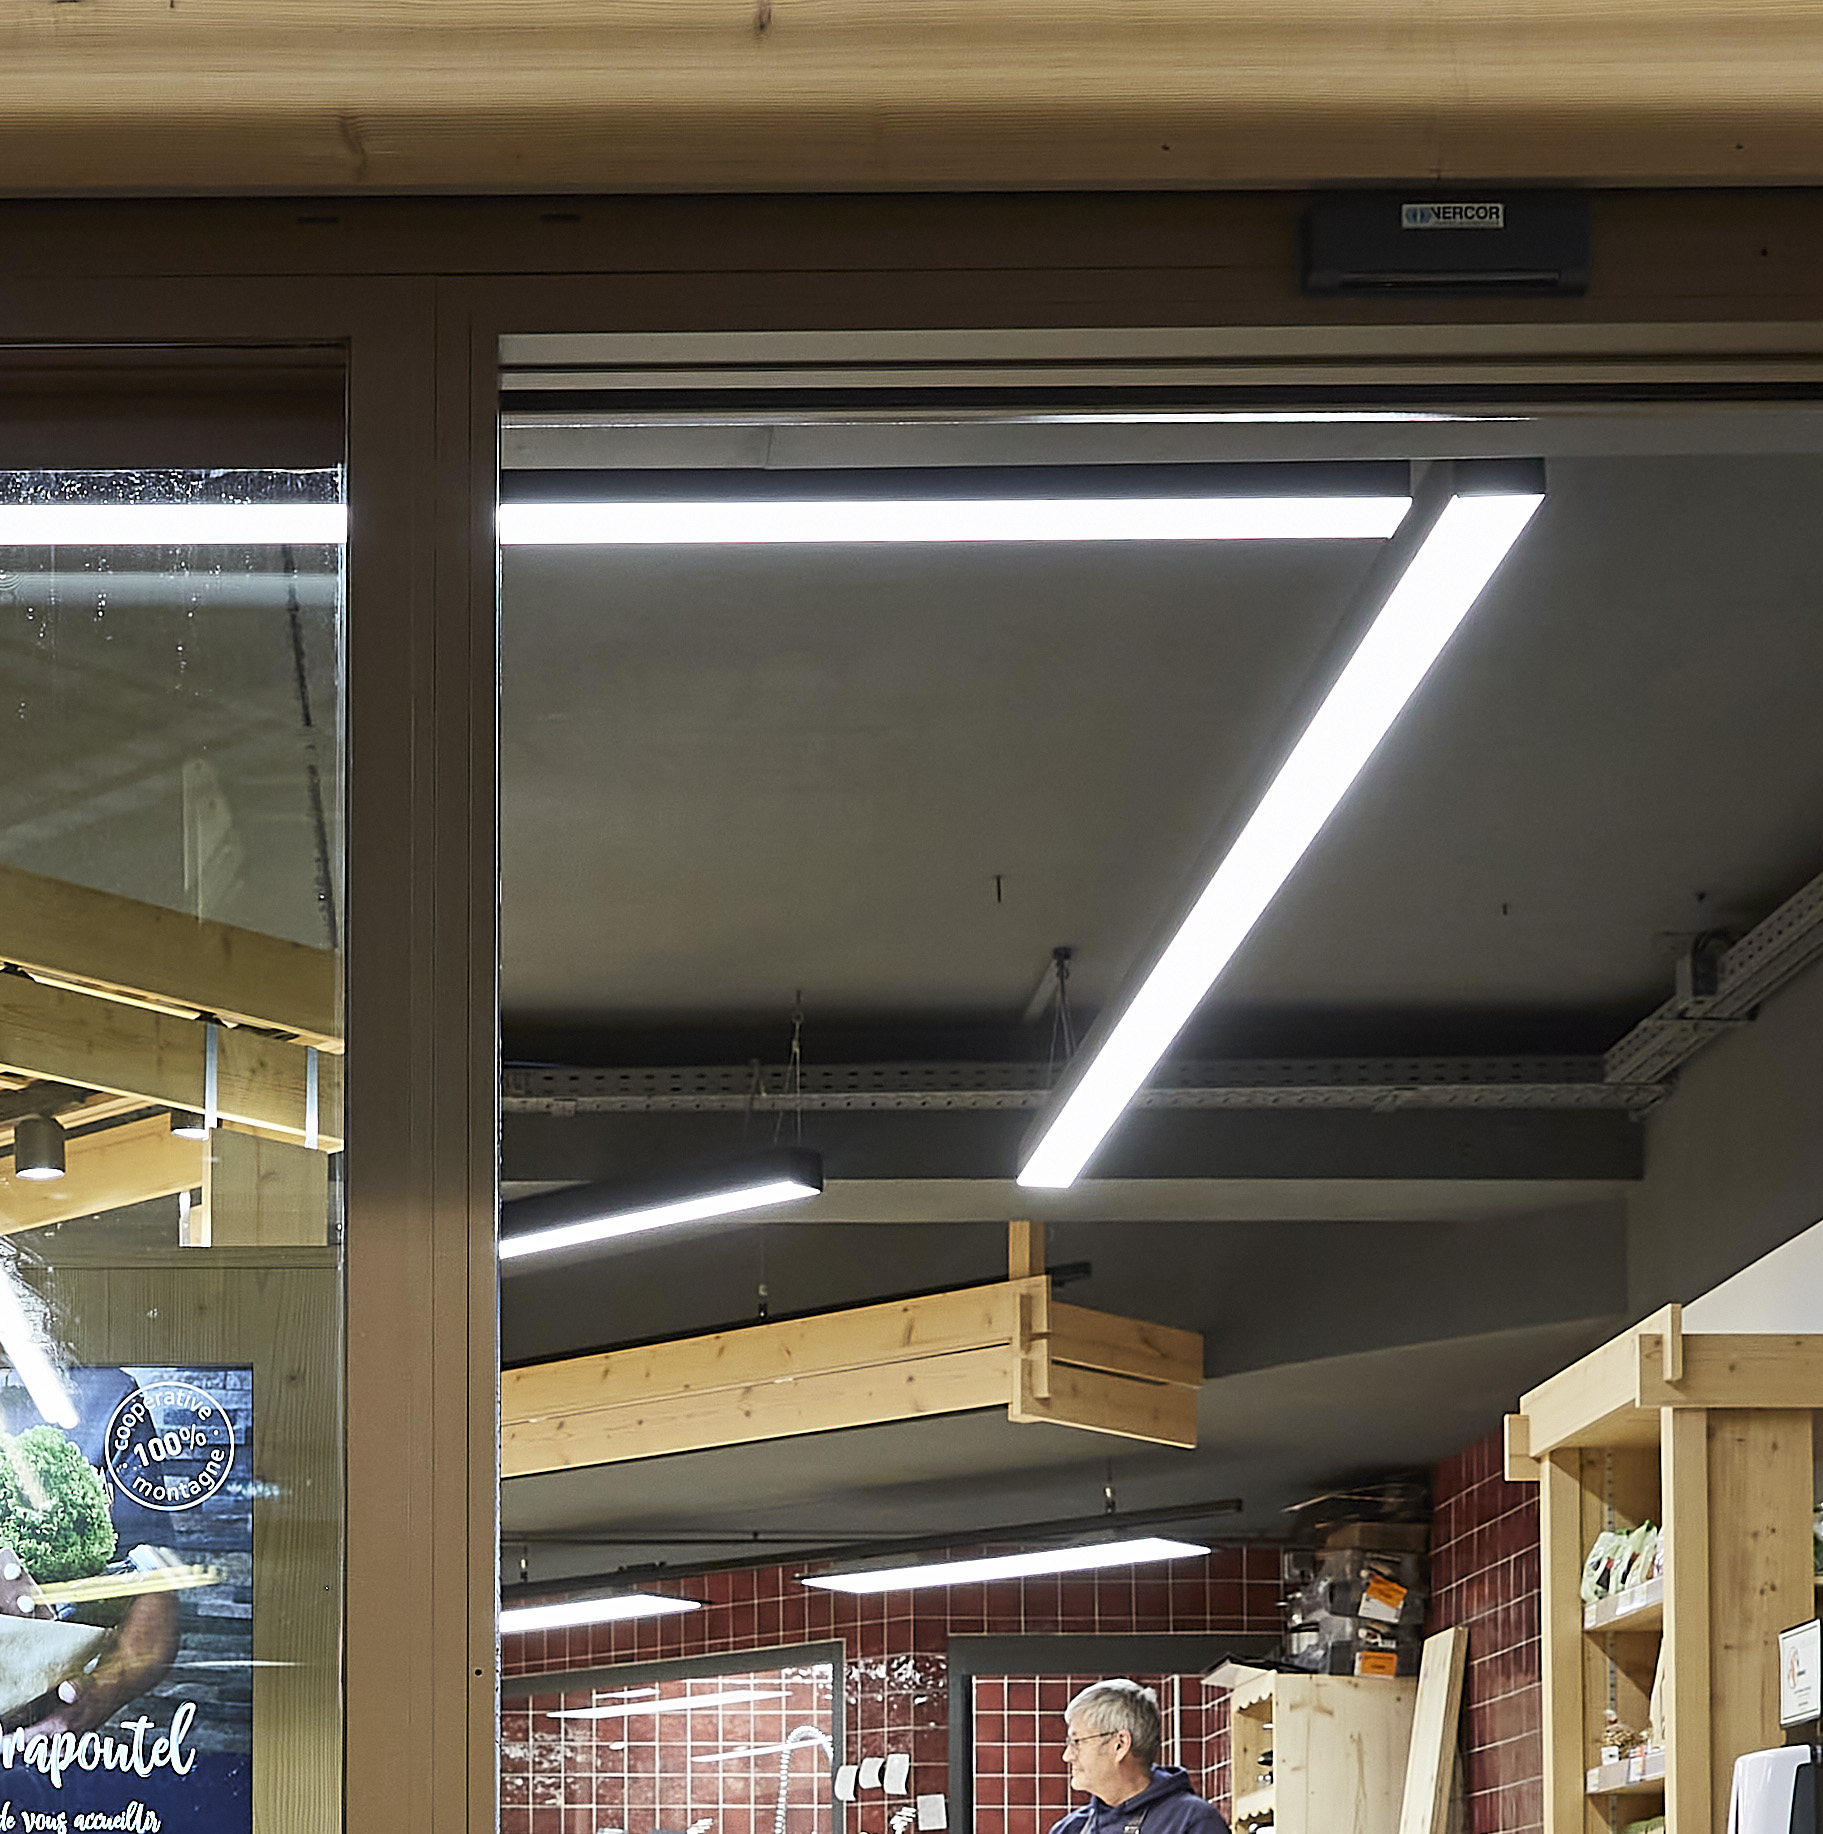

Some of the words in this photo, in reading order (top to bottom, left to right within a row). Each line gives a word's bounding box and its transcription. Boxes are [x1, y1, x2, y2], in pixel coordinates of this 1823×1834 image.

[1431, 206, 1500, 220] VERCOR
[133, 1423, 207, 1467] 100%
[132, 1449, 225, 1501] montagne
[73, 1801, 162, 1834] accueillir
